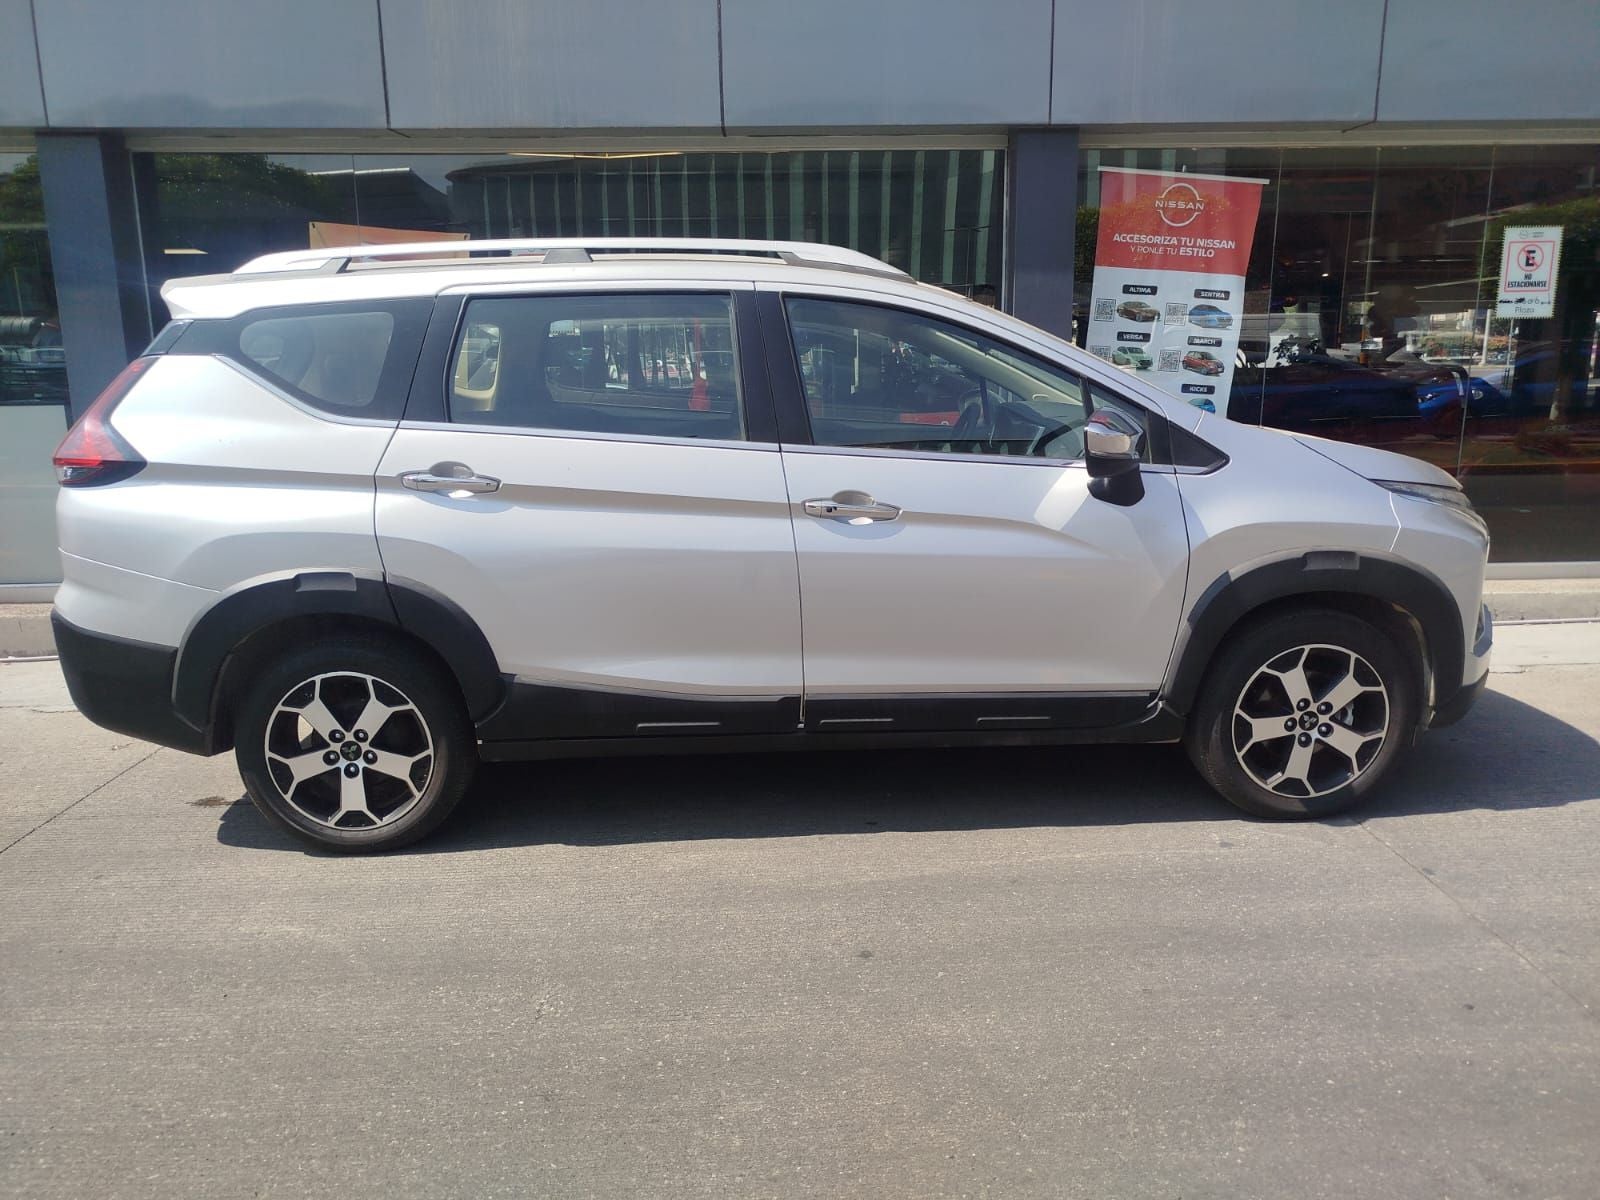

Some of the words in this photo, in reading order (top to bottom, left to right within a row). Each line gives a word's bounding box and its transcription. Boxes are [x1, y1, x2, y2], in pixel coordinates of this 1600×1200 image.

[1155, 200, 1204, 210] NISSAN
[1113, 233, 1178, 245] ACCESORIZA
[1181, 237, 1194, 246] TU
[1196, 238, 1236, 249] NISSAN
[1137, 246, 1165, 255] PONLE
[1179, 247, 1215, 258] ESTILO
[1525, 250, 1537, 267] E
[1122, 332, 1144, 340] VERSA
